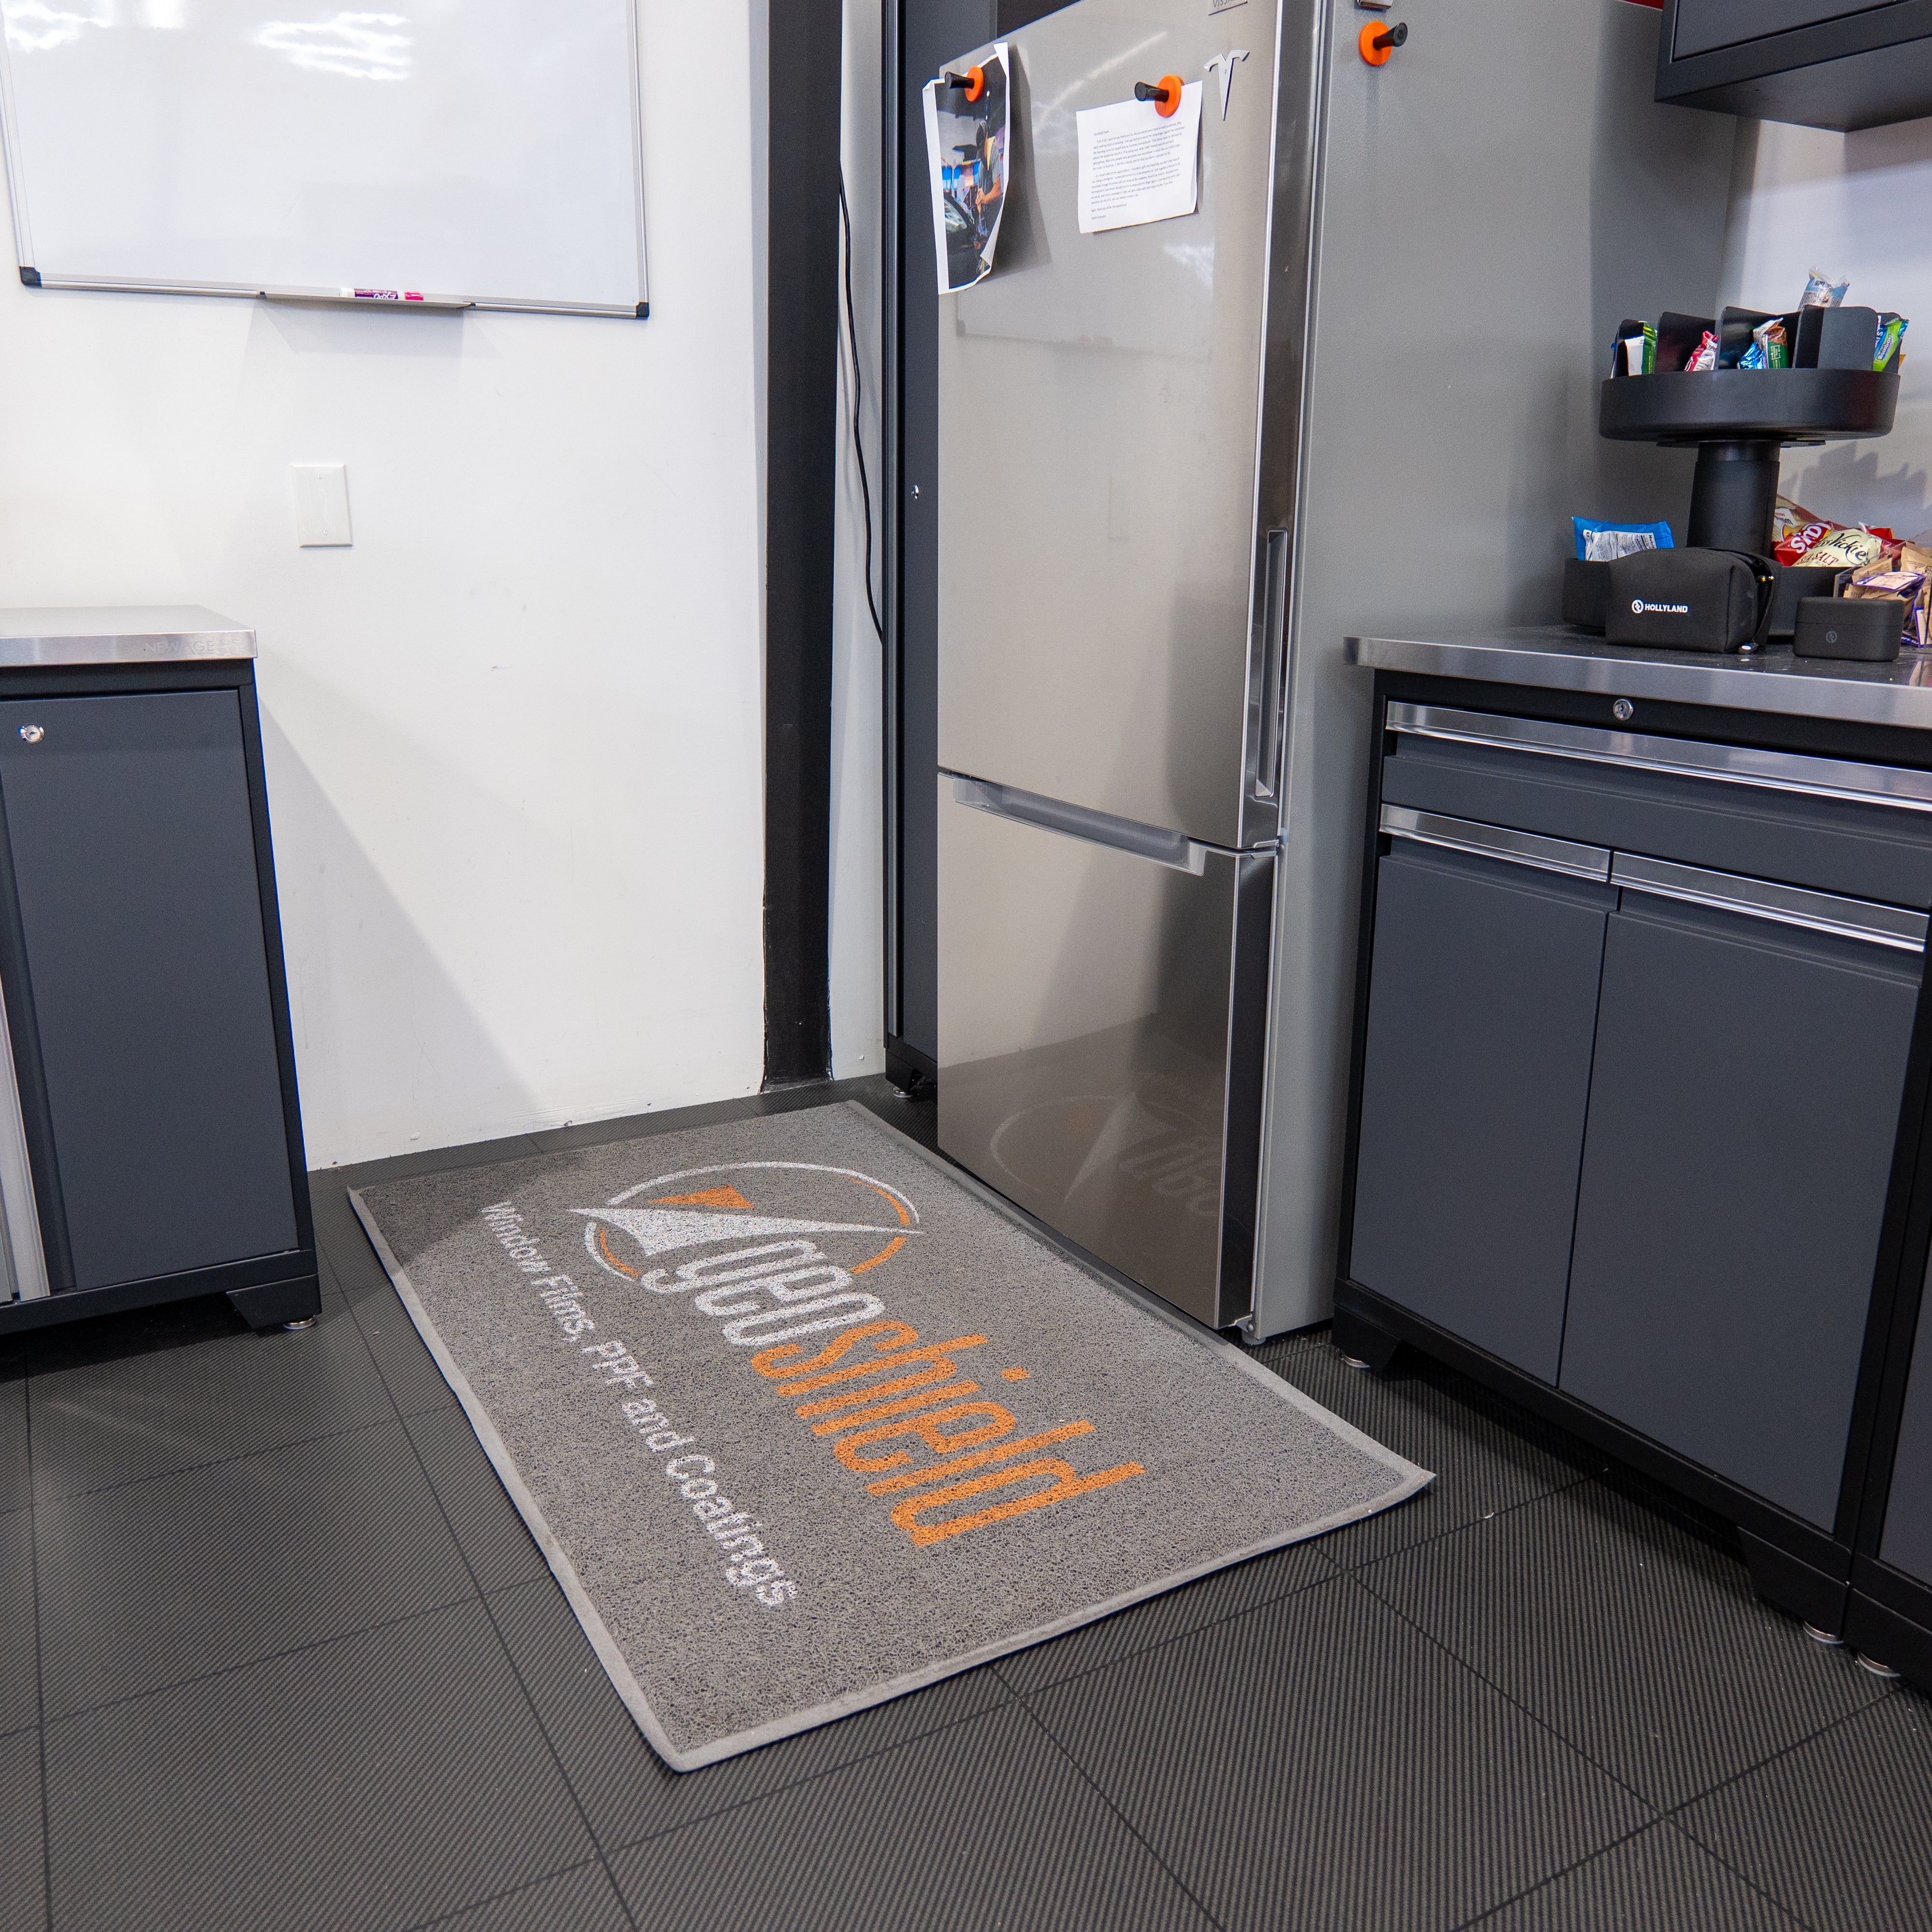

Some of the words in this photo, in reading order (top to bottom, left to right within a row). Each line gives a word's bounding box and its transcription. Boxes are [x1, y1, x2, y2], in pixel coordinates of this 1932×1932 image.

[1812, 551, 1839, 566] SALT
[1645, 603, 1688, 613] HOLLYLAND
[479, 1201, 552, 1272] Window
[581, 1340, 654, 1389] PPF
[622, 1399, 696, 1452] and
[666, 1454, 798, 1606] Coatings
